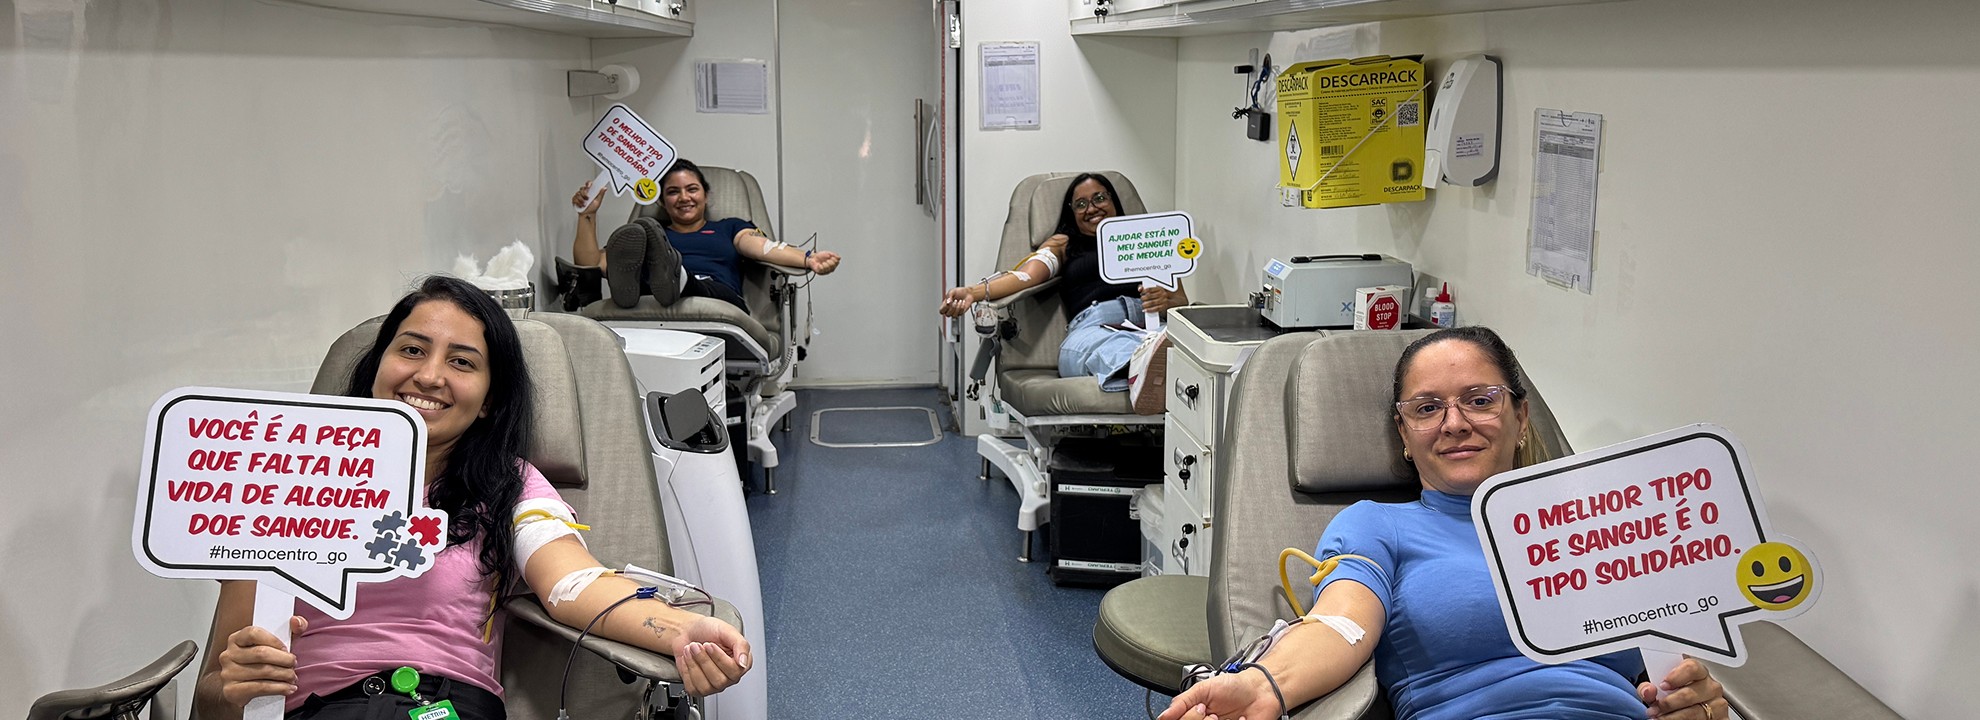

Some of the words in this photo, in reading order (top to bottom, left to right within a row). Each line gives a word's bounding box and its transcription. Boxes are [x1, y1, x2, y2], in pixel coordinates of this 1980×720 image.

[1321, 70, 1417, 88] DESCARPACK
[598, 132, 615, 148] TIPO
[614, 146, 649, 178] SOLIDÁRIO.
[607, 126, 618, 136] DE
[617, 134, 644, 158] SANGUE
[642, 154, 652, 162] É
[619, 123, 647, 147] MELHOR
[647, 145, 663, 161] TIPO
[1383, 185, 1422, 193] DESCARPACK
[1108, 233, 1142, 242] AJUDAR
[1145, 227, 1166, 239] ESTÁ
[1168, 228, 1180, 236] NO
[1117, 243, 1135, 252] MEU
[1137, 239, 1173, 250] SANGUE!
[1117, 253, 1134, 262] DOE
[1136, 249, 1173, 260] MEDULA!
[1374, 302, 1395, 312] BLOOD
[1376, 312, 1392, 321] STOP
[188, 410, 259, 441] VOCÊ
[264, 414, 284, 442] É
[288, 424, 308, 445] A
[315, 425, 381, 452] PEÇA
[187, 449, 242, 472] QUE
[249, 452, 331, 476] FALTA
[338, 457, 375, 479] NA
[167, 480, 234, 504] VIDA
[241, 484, 279, 505] DE
[284, 480, 391, 510] ALGUÉM
[1513, 513, 1531, 535] O
[1537, 484, 1642, 530] MELHOR
[1648, 468, 1712, 501] TIPO
[188, 514, 245, 536] DOE
[250, 514, 359, 541] SANGUE.
[1526, 539, 1561, 567] DE
[1568, 513, 1668, 556] SANGUE
[1675, 498, 1692, 531] É
[1700, 501, 1719, 525] O
[209, 545, 348, 565] #hemocentro_go
[1526, 568, 1587, 600] TIPO
[1595, 534, 1741, 585] SOLIDÁRIO.
[1582, 595, 1719, 635] #hemocentro_go
